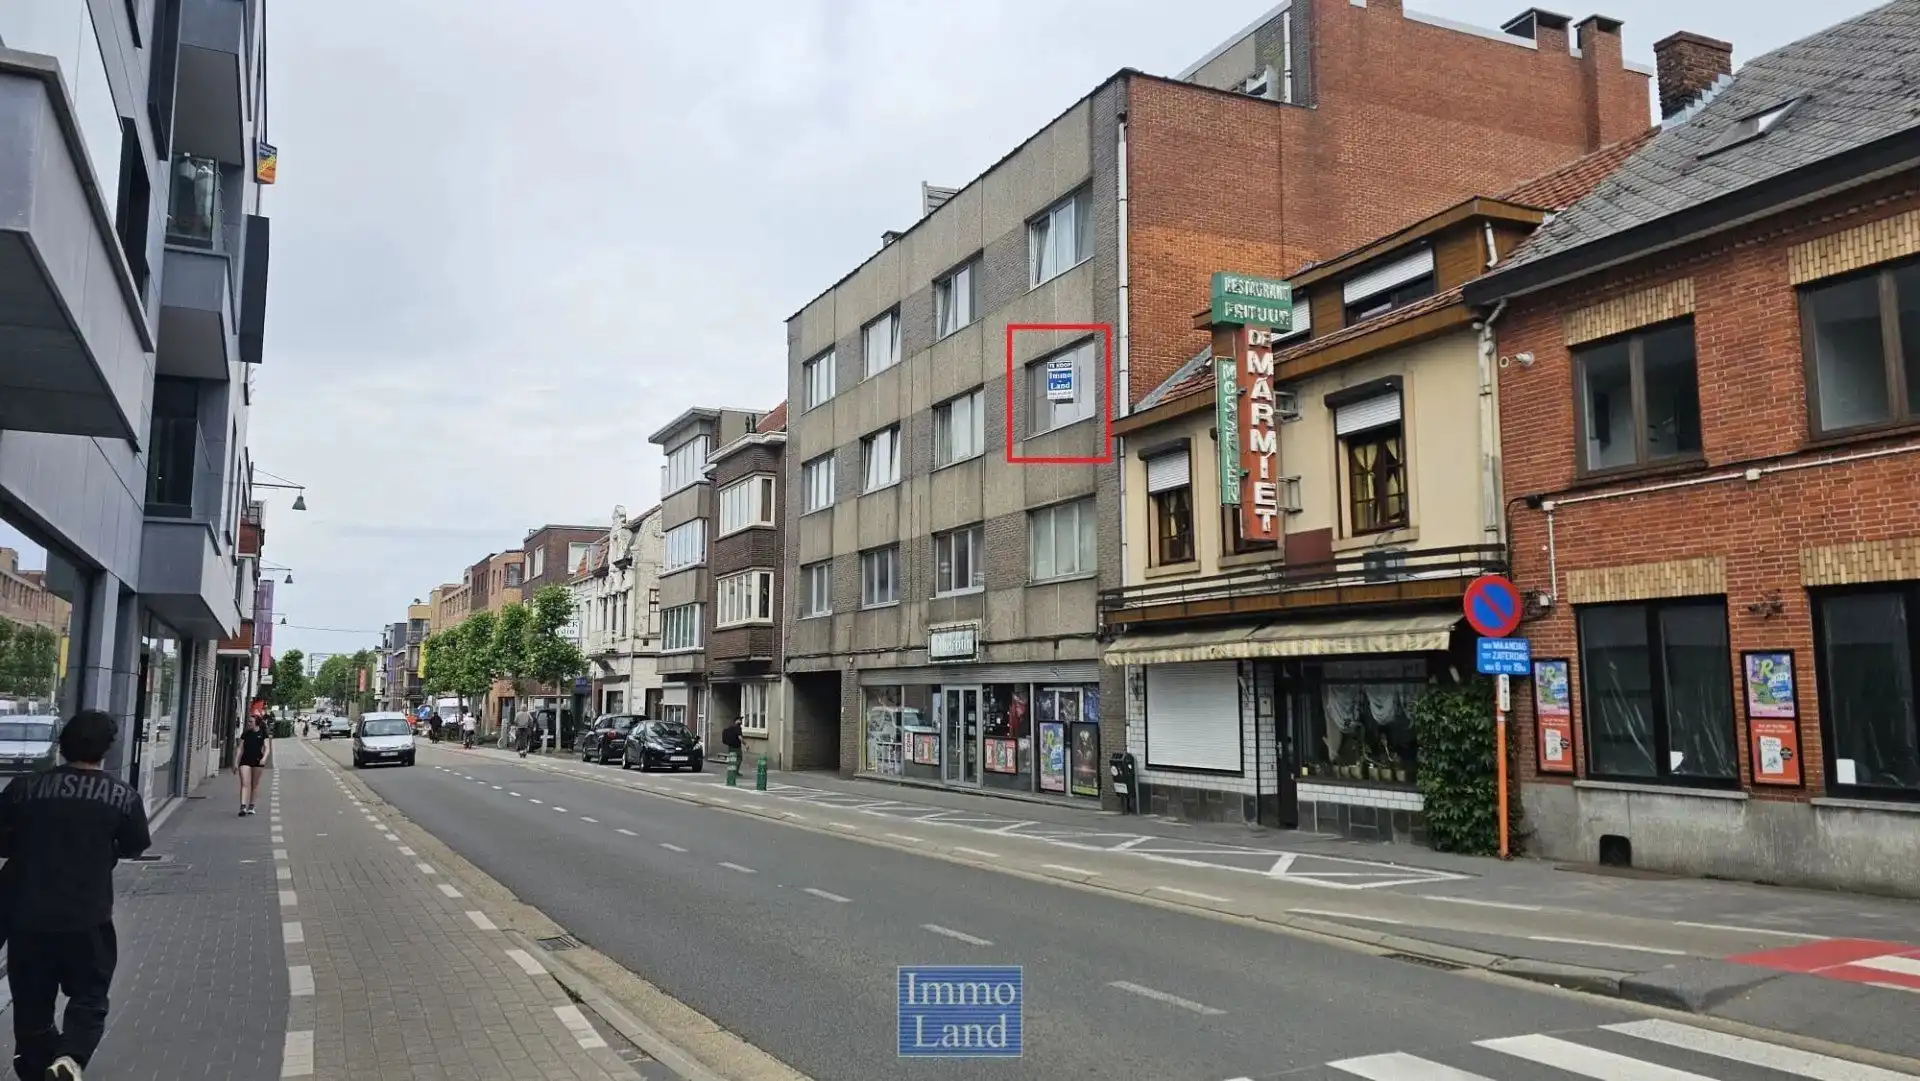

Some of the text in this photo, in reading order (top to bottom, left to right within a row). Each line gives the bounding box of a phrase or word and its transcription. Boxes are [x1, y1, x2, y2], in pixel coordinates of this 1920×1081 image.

[1224, 277, 1292, 300] RESTAURANT
[1225, 302, 1290, 325] FRITUUR
[1248, 329, 1272, 347] DE
[1050, 382, 1071, 390] Land
[1247, 350, 1278, 532] MARMIET
[1493, 641, 1527, 650] MAANDAG
[1492, 651, 1528, 661] ZATERDAG
